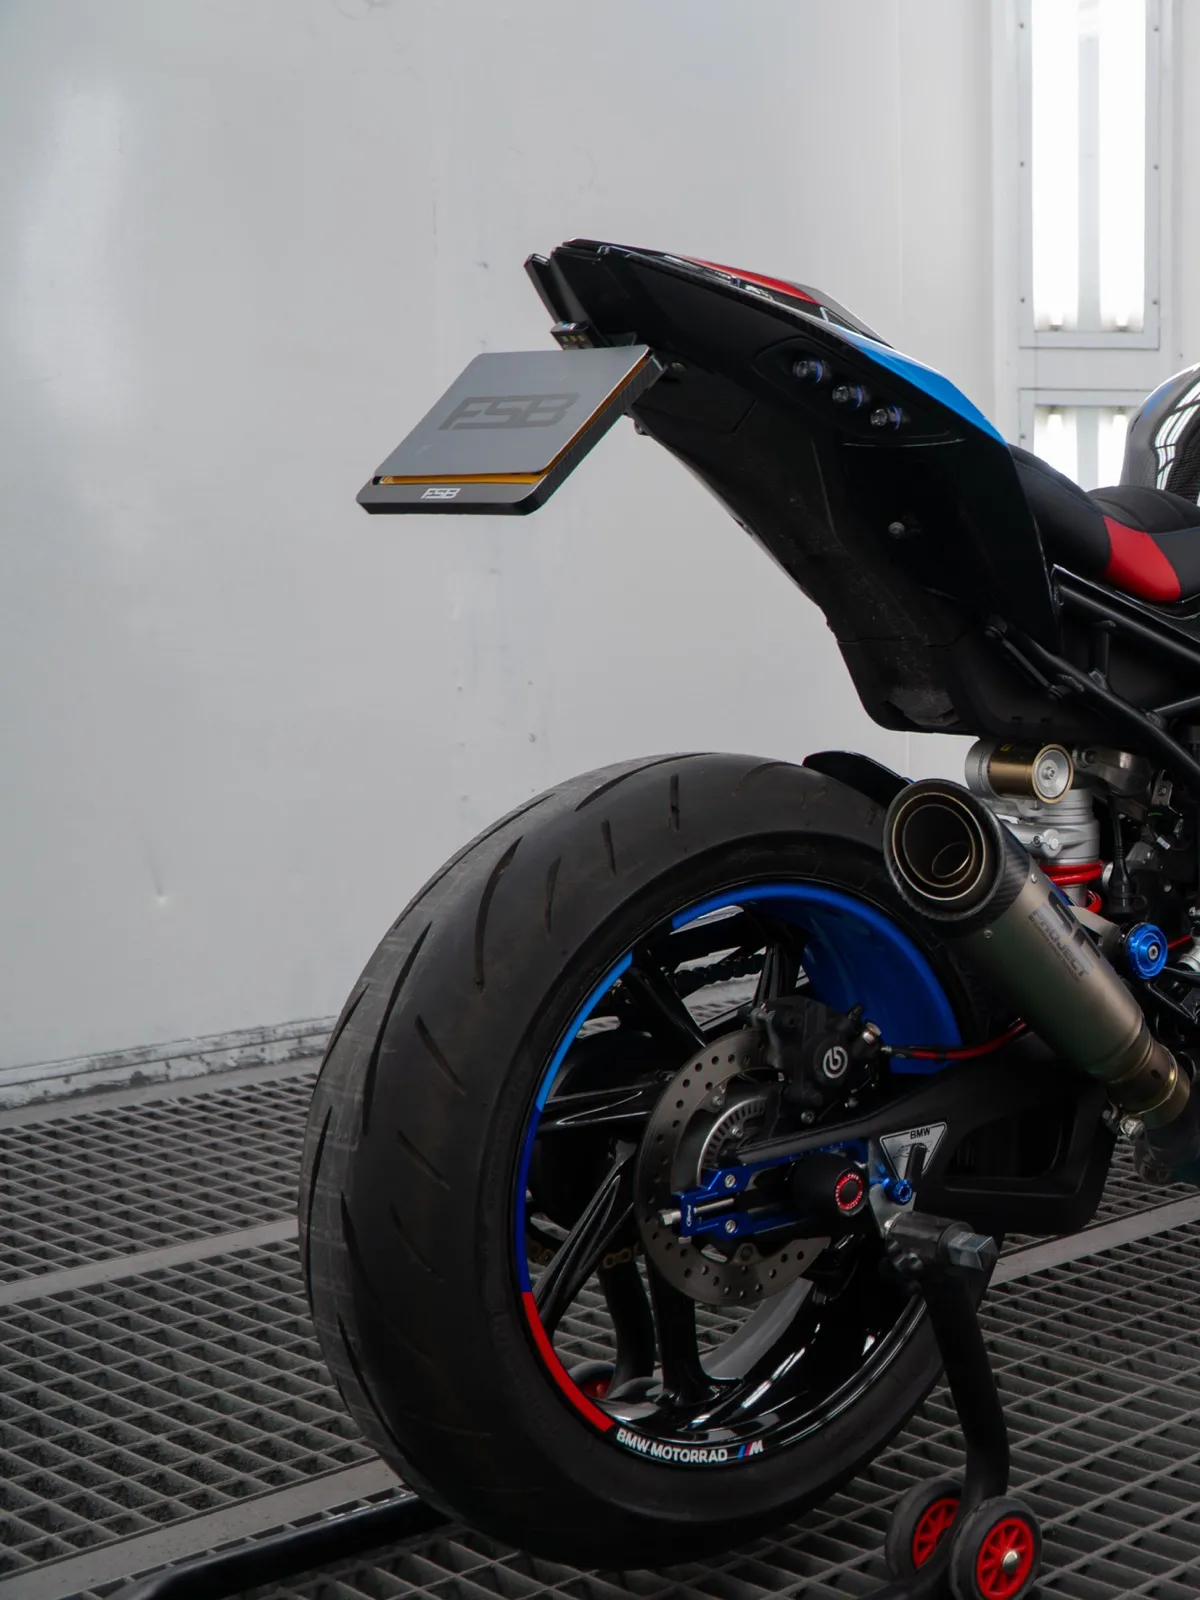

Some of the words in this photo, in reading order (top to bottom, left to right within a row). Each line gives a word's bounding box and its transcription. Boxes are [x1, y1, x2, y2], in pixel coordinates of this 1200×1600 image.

[909, 1127, 931, 1140] BMW
[616, 1427, 651, 1454] BMW
[650, 1444, 729, 1463] MOTORRAD
